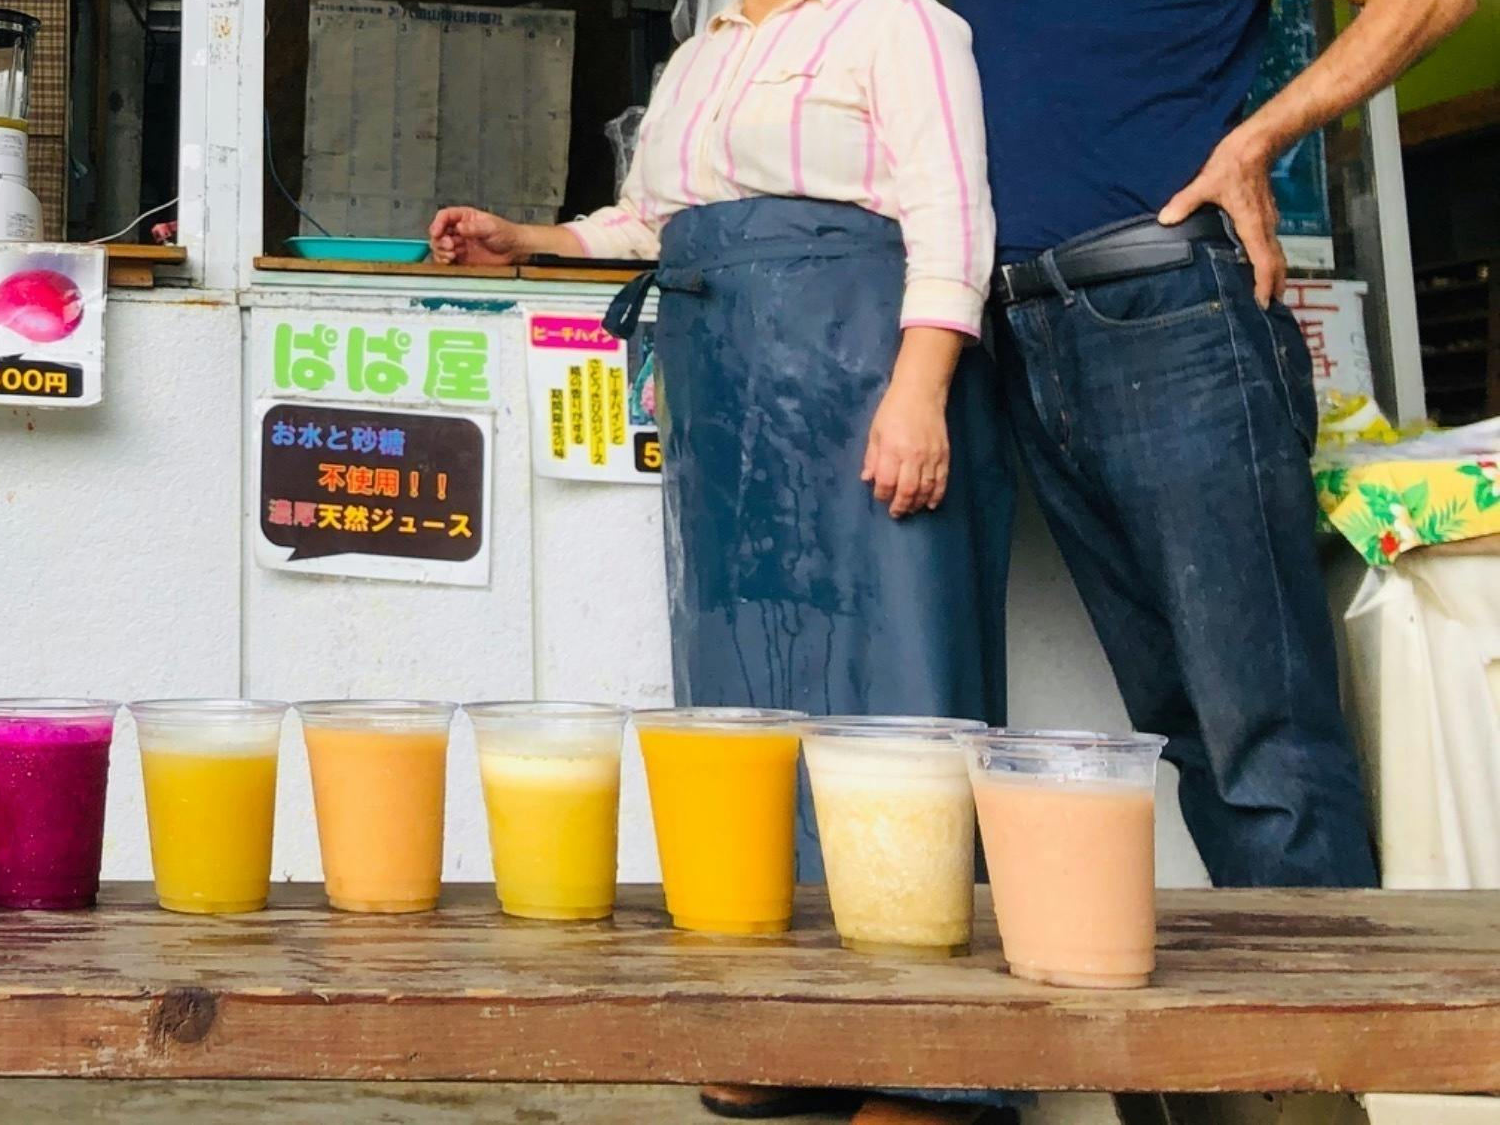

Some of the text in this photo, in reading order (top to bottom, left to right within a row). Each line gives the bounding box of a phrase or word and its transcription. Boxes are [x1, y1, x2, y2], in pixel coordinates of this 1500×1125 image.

[274, 322, 490, 402] ぱぱ屋
[270, 420, 406, 457] お水と砂糖
[267, 499, 473, 539] 濃厚天然ジュース
